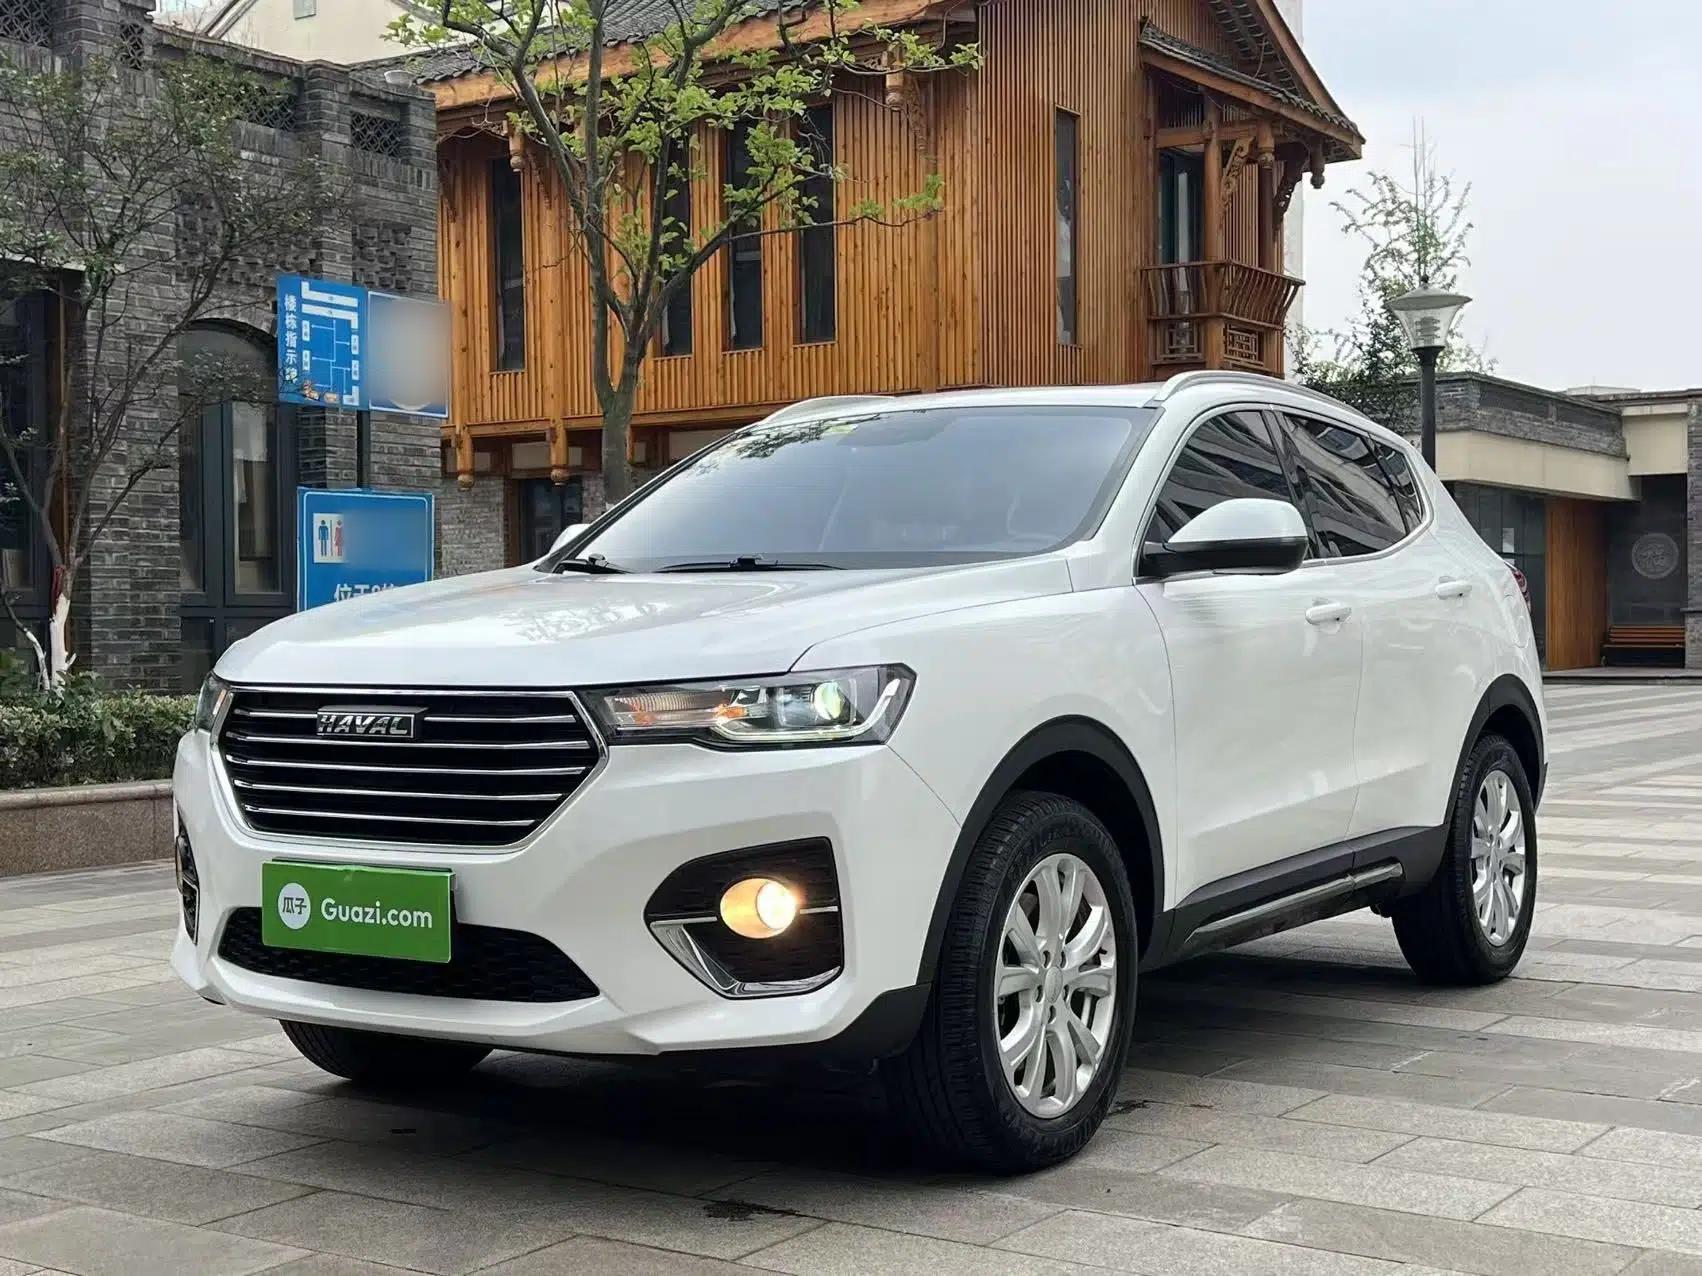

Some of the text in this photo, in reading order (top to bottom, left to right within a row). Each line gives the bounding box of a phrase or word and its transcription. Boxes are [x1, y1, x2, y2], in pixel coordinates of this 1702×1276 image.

[318, 715, 408, 735] HAVAL
[282, 896, 307, 915] 瓜子
[320, 897, 433, 929] Guazi.com
